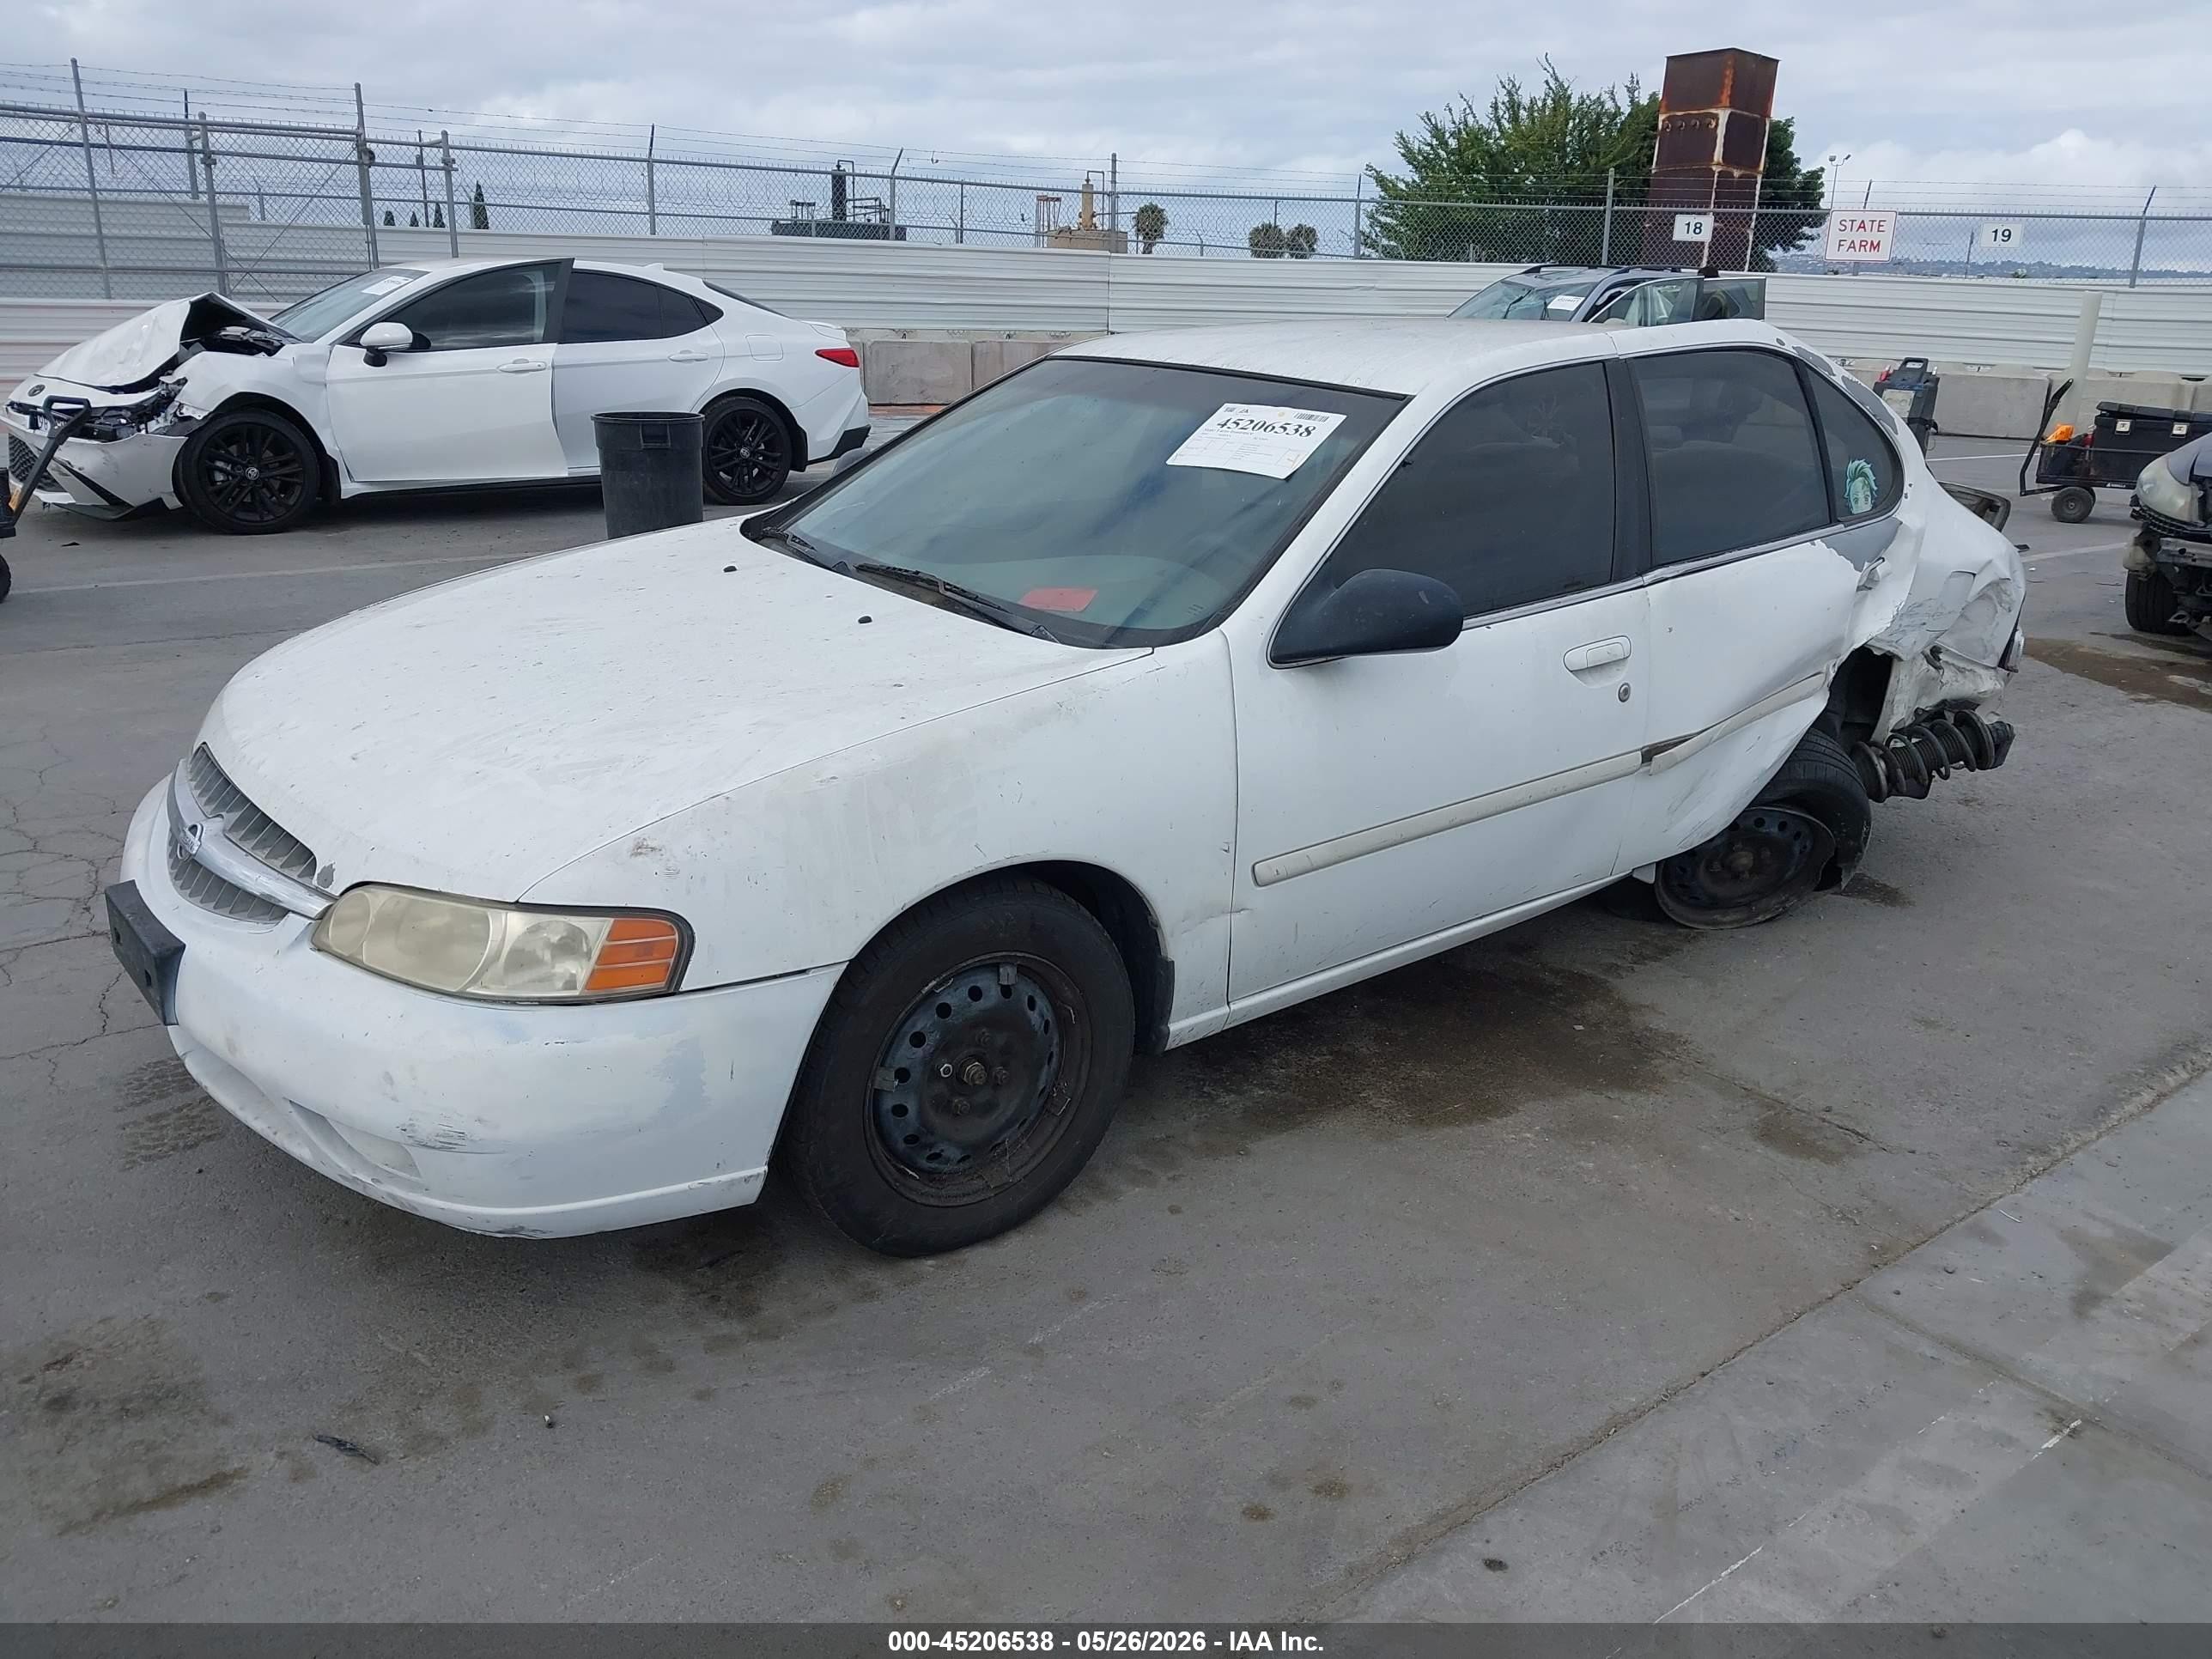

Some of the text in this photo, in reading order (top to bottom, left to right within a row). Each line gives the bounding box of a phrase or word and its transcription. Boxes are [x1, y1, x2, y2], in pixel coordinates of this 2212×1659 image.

[1685, 221, 1703, 235] 18
[1838, 219, 1887, 233] STATE
[1991, 228, 2012, 243] 19
[1837, 239, 1881, 252] FARM
[1217, 417, 1316, 438] 45206538
